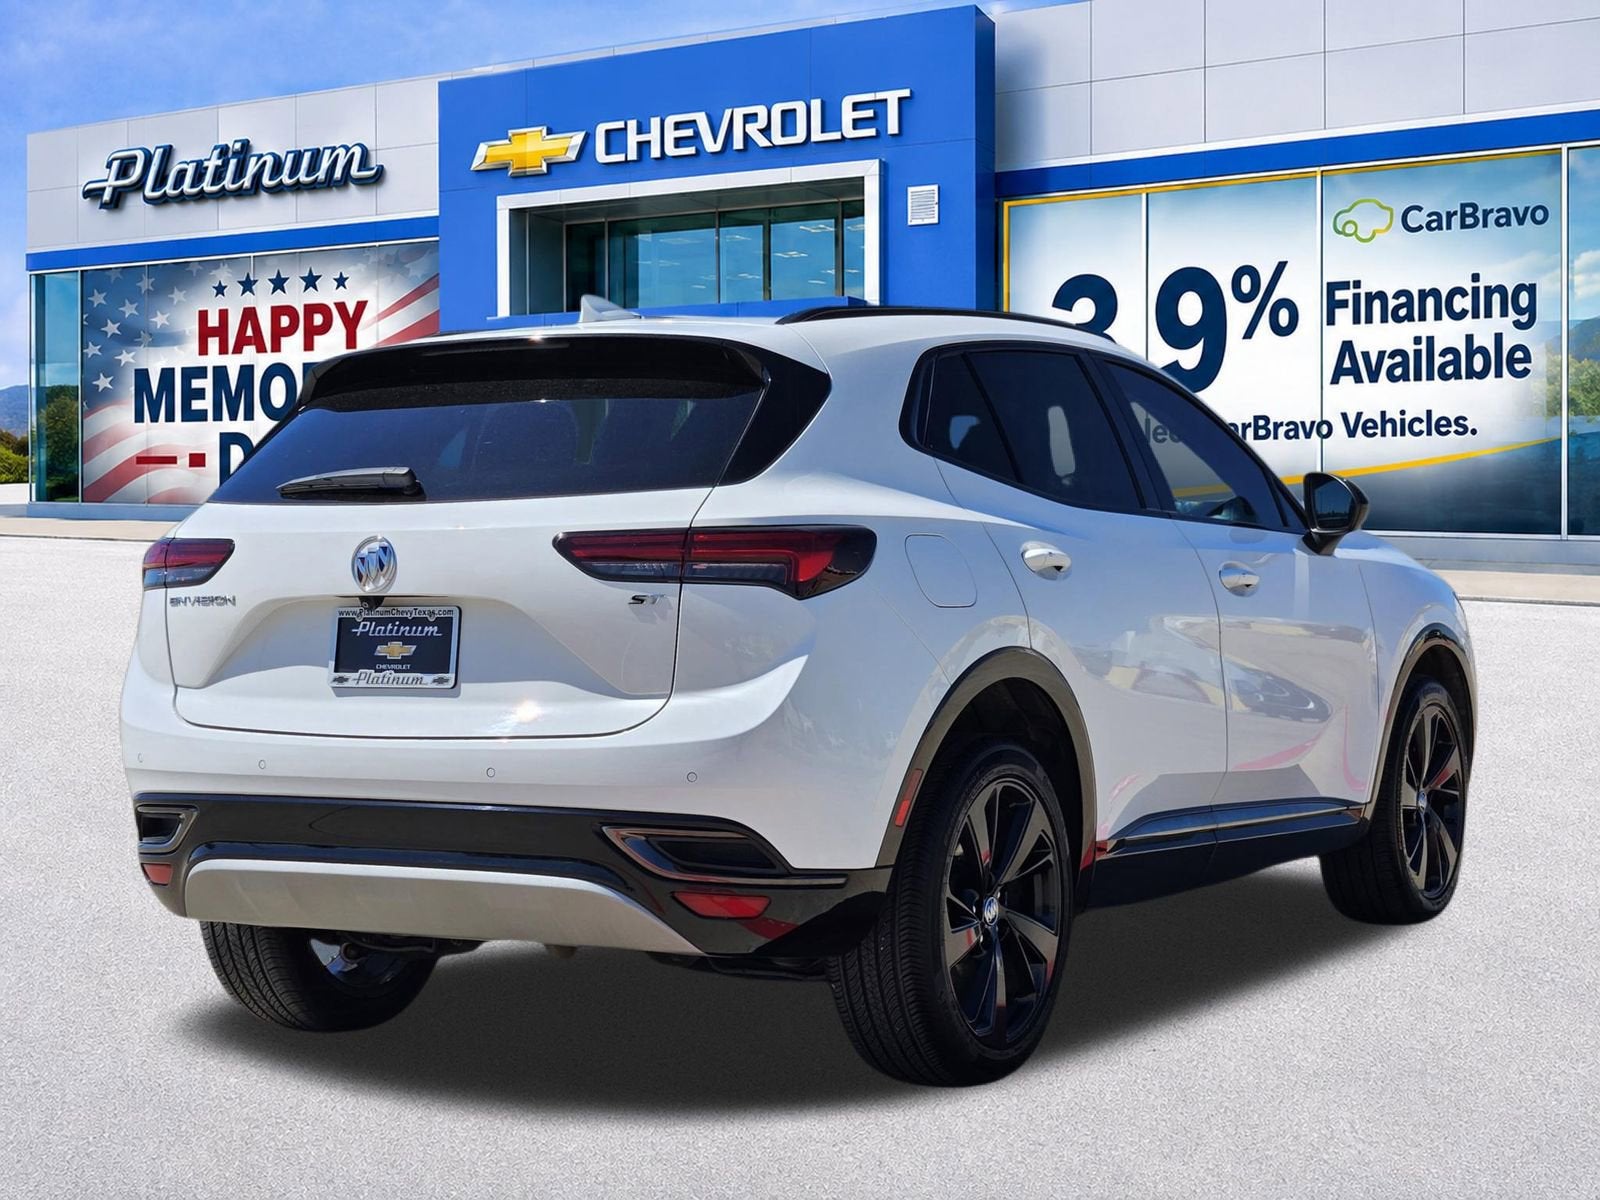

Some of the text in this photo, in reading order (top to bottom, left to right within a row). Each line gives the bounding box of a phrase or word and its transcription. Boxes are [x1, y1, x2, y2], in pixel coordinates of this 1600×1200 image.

[595, 88, 911, 164] CHEVROLET
[83, 139, 383, 209] Platinum
[1401, 202, 1549, 233] CarBravo
[198, 300, 368, 356] HAPPY
[1052, 261, 1299, 393] 39%
[1326, 272, 1538, 330] Financing
[1330, 332, 1532, 385] Available
[134, 362, 320, 423] MEMO
[1228, 410, 1478, 441] rBravo Vehicles.
[338, 608, 454, 618] www.PlatinumChevyTexas.com
[352, 621, 442, 636] Platinum
[352, 671, 429, 685] Platinum
